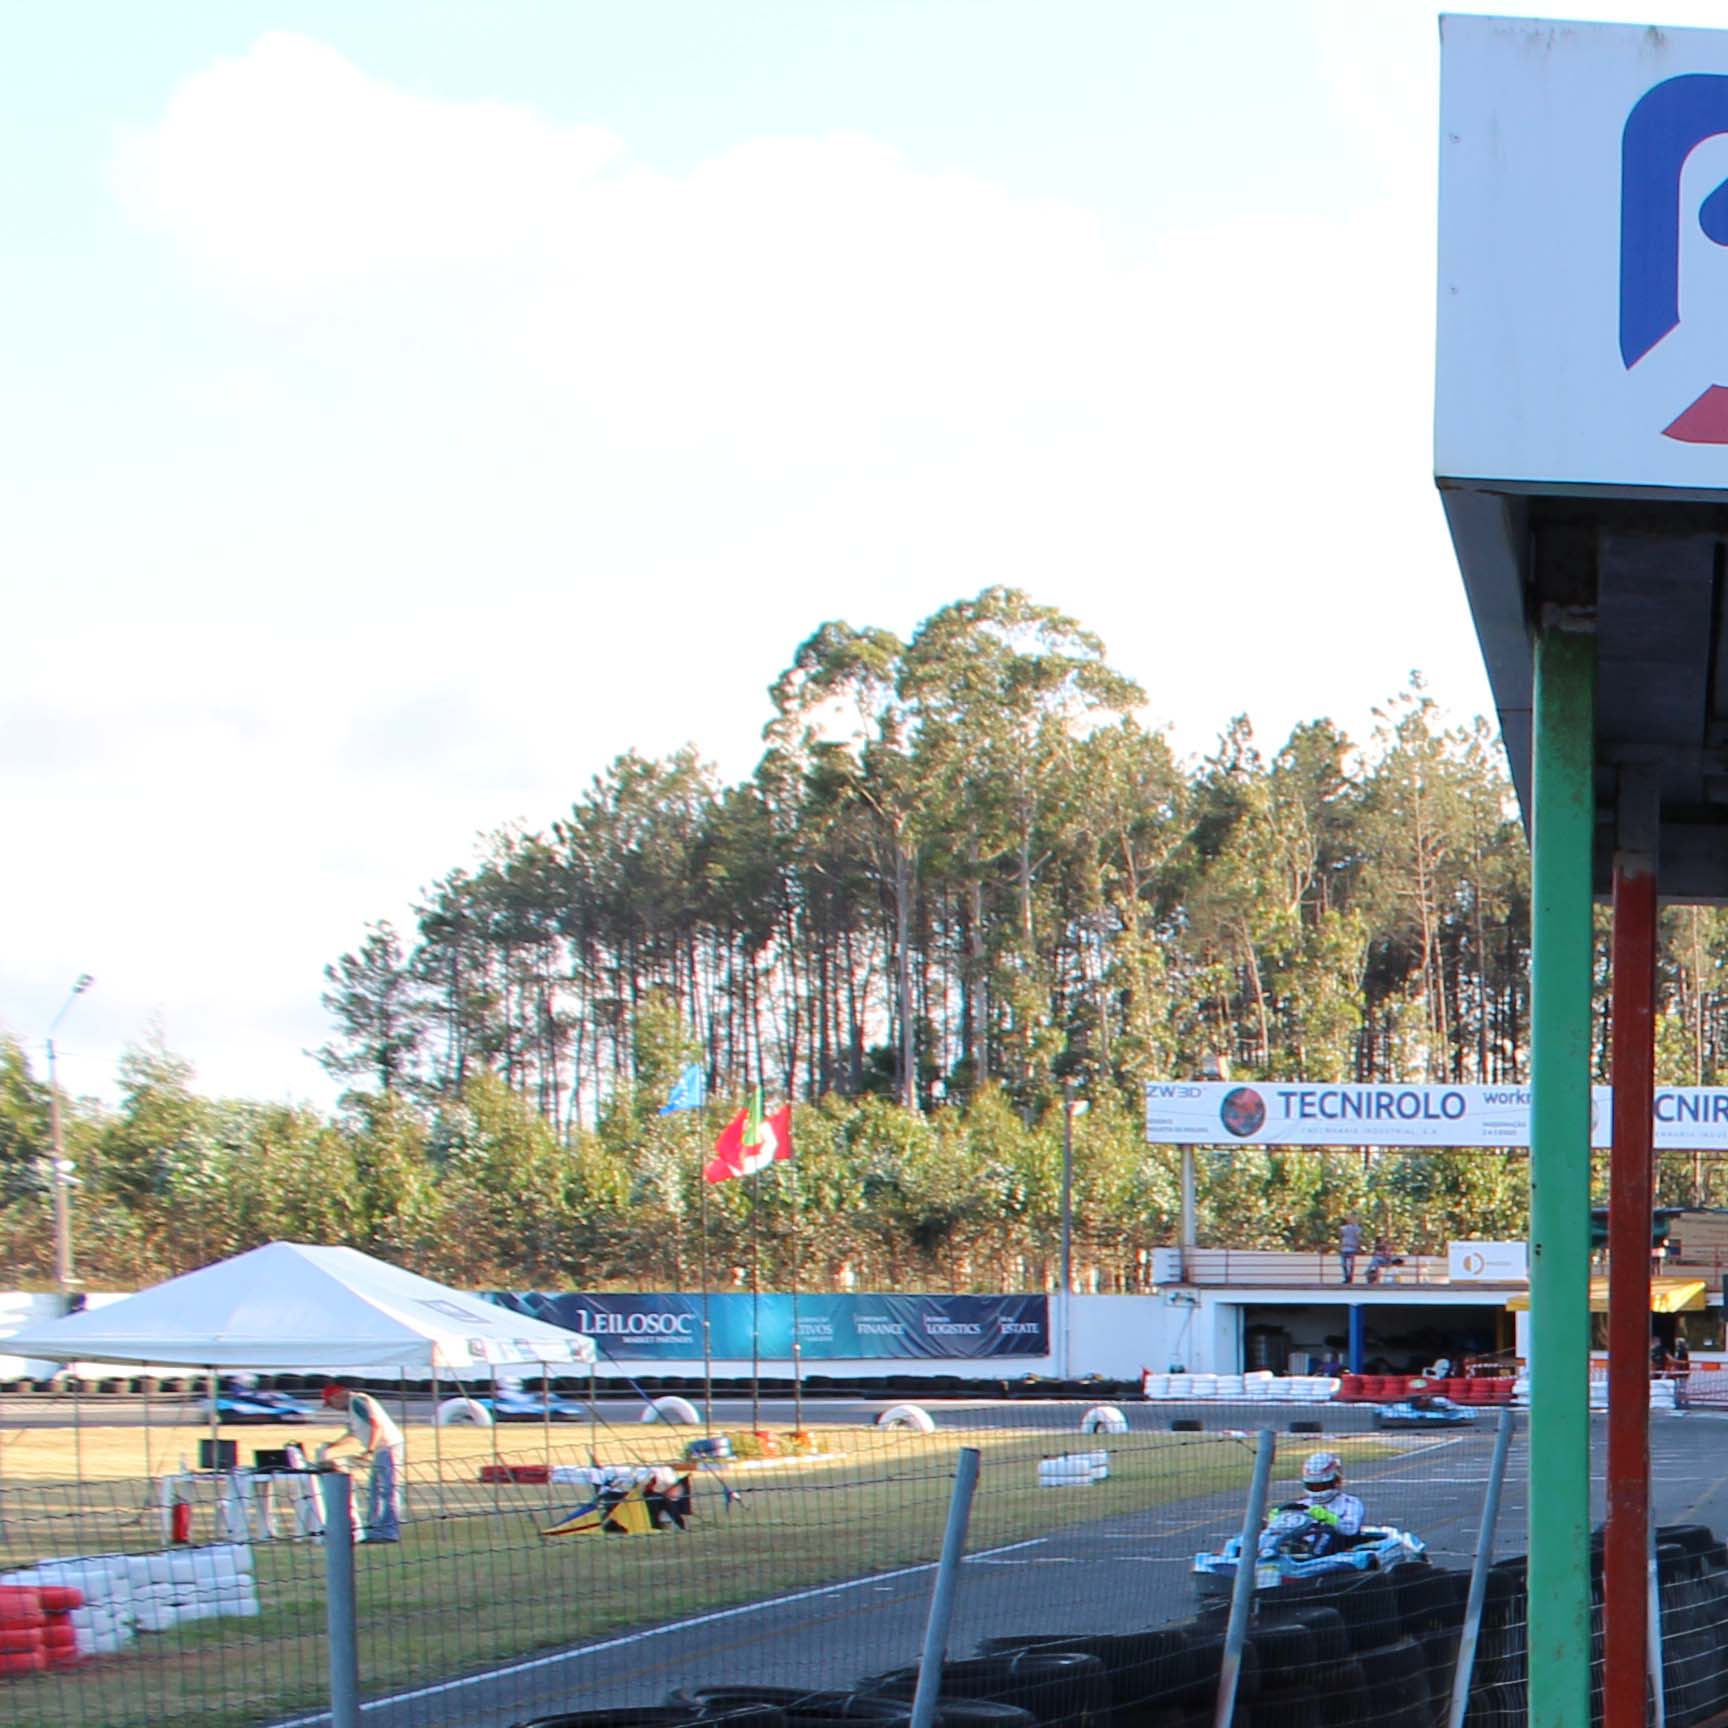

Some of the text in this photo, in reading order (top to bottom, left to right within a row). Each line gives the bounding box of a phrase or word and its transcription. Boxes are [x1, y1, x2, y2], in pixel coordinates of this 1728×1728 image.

[1277, 1091, 1467, 1120] TECNIROLO
[576, 1309, 696, 1335] LEILOSOC
[856, 1322, 905, 1335] FINANCE
[926, 1322, 982, 1336] LOGISTICS
[1001, 1322, 1040, 1335] ESTATE
